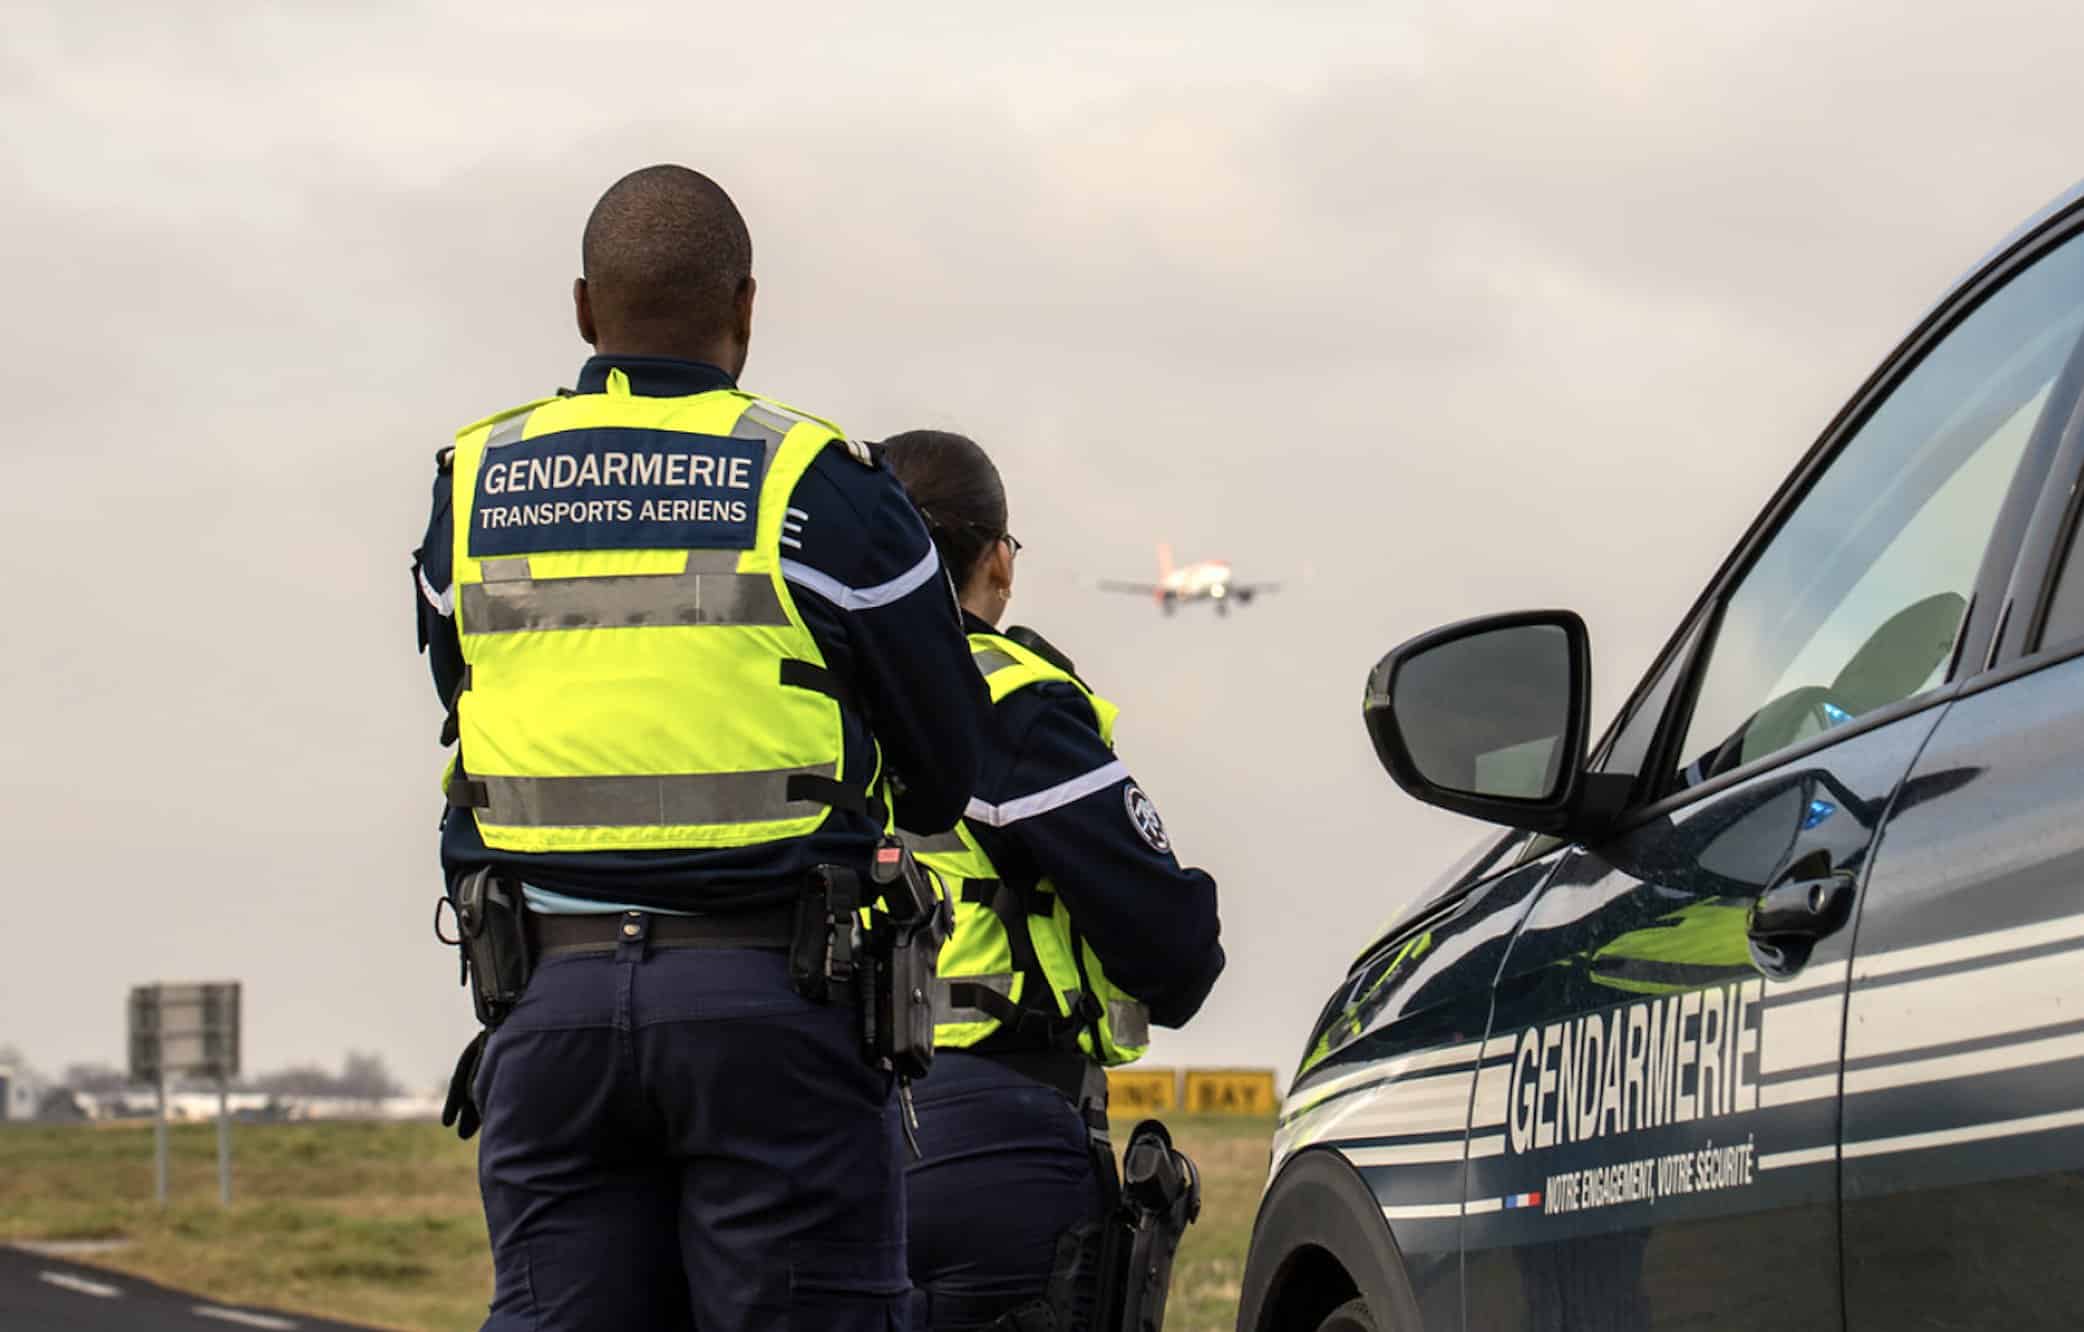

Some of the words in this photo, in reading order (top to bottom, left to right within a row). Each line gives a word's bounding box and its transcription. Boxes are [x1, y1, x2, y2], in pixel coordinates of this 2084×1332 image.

[484, 452, 753, 495] GENDARMERIE
[480, 500, 633, 529] TRANSPORTS
[639, 500, 747, 523] AERIENS
[1510, 978, 1763, 1155] GENDARMERIE
[1544, 1171, 1582, 1215] NOTRE
[1581, 1158, 1656, 1206] ENGAGEMENT,
[1656, 1152, 1695, 1198] VOTRE
[1695, 1132, 1755, 1191] SÉCURITÉ
